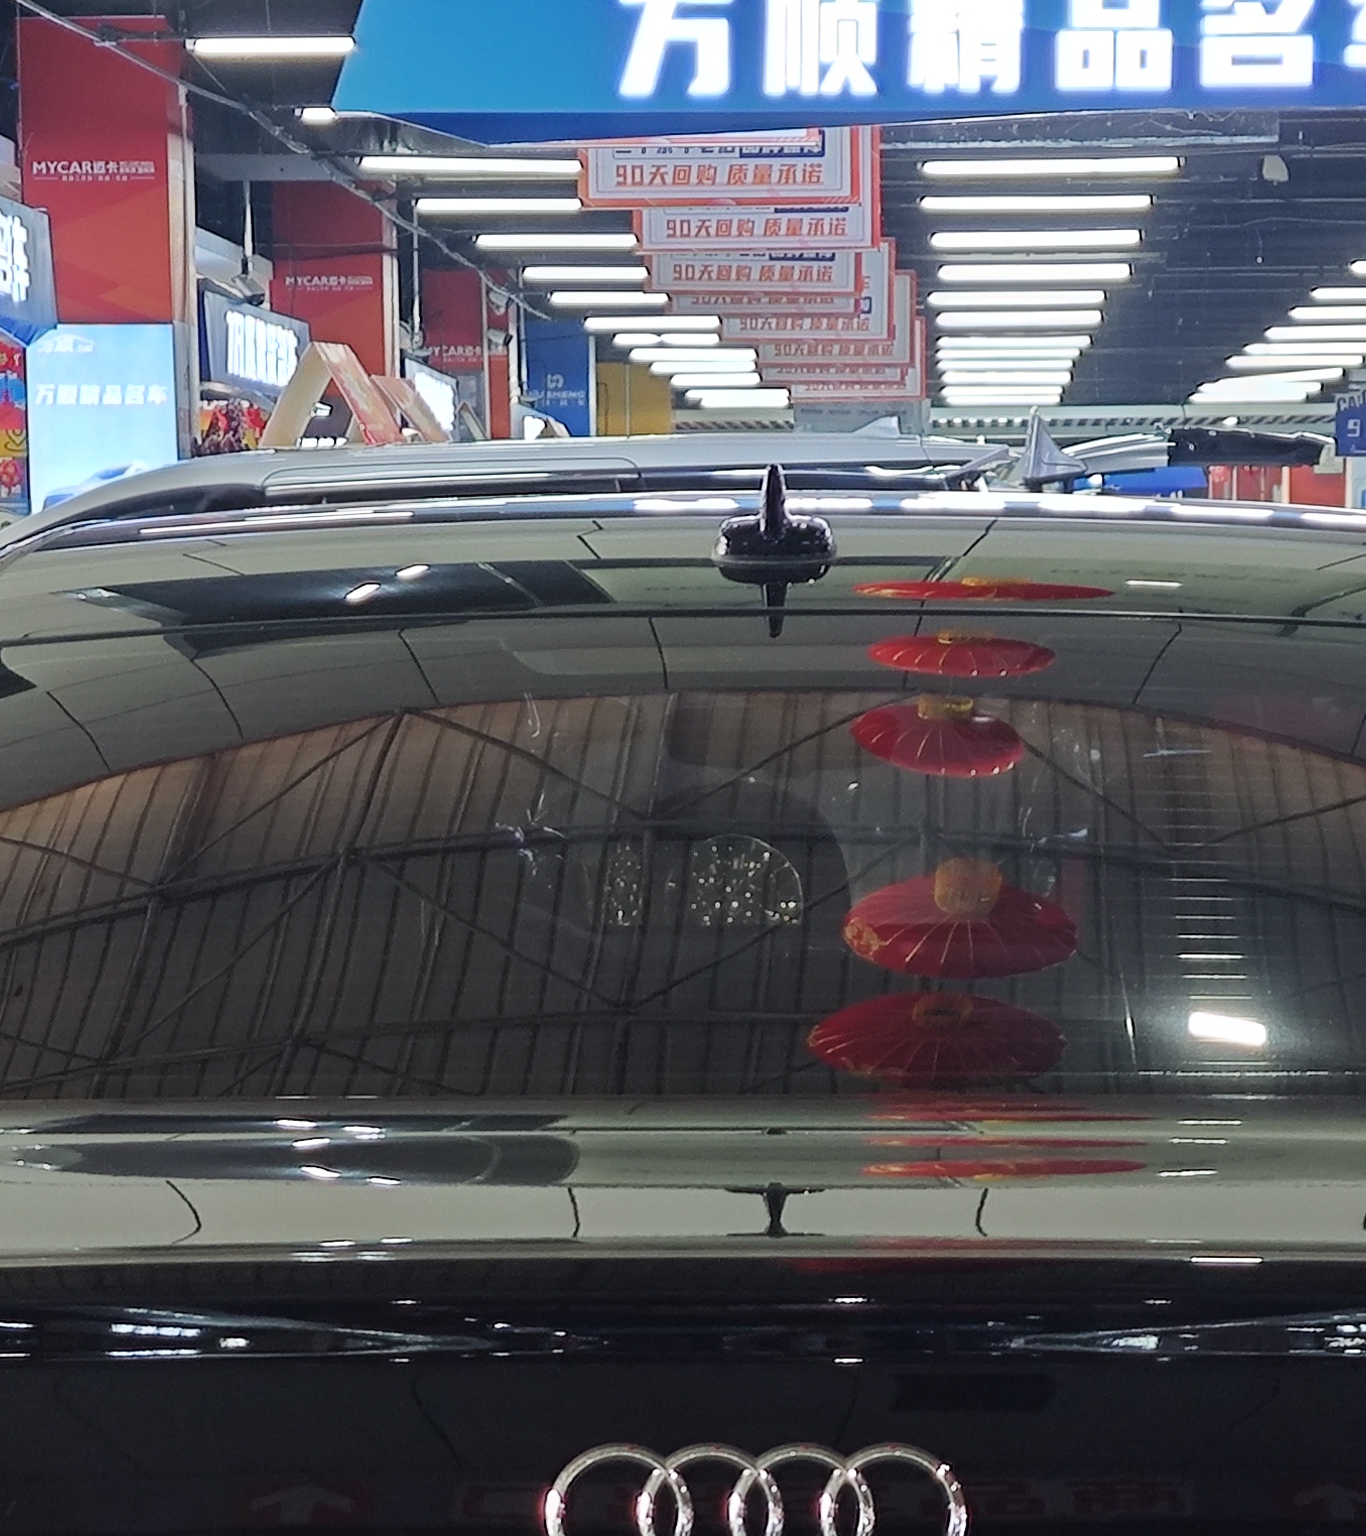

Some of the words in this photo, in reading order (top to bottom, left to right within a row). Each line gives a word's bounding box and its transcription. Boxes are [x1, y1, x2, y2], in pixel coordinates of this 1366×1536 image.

[615, 164, 716, 186] 90天回购
[727, 163, 823, 184] 质量承诺
[666, 218, 755, 238] 90天回购
[763, 217, 846, 236] 质量承诺
[673, 264, 751, 282] 90天回购
[759, 264, 834, 282] 质量承诺
